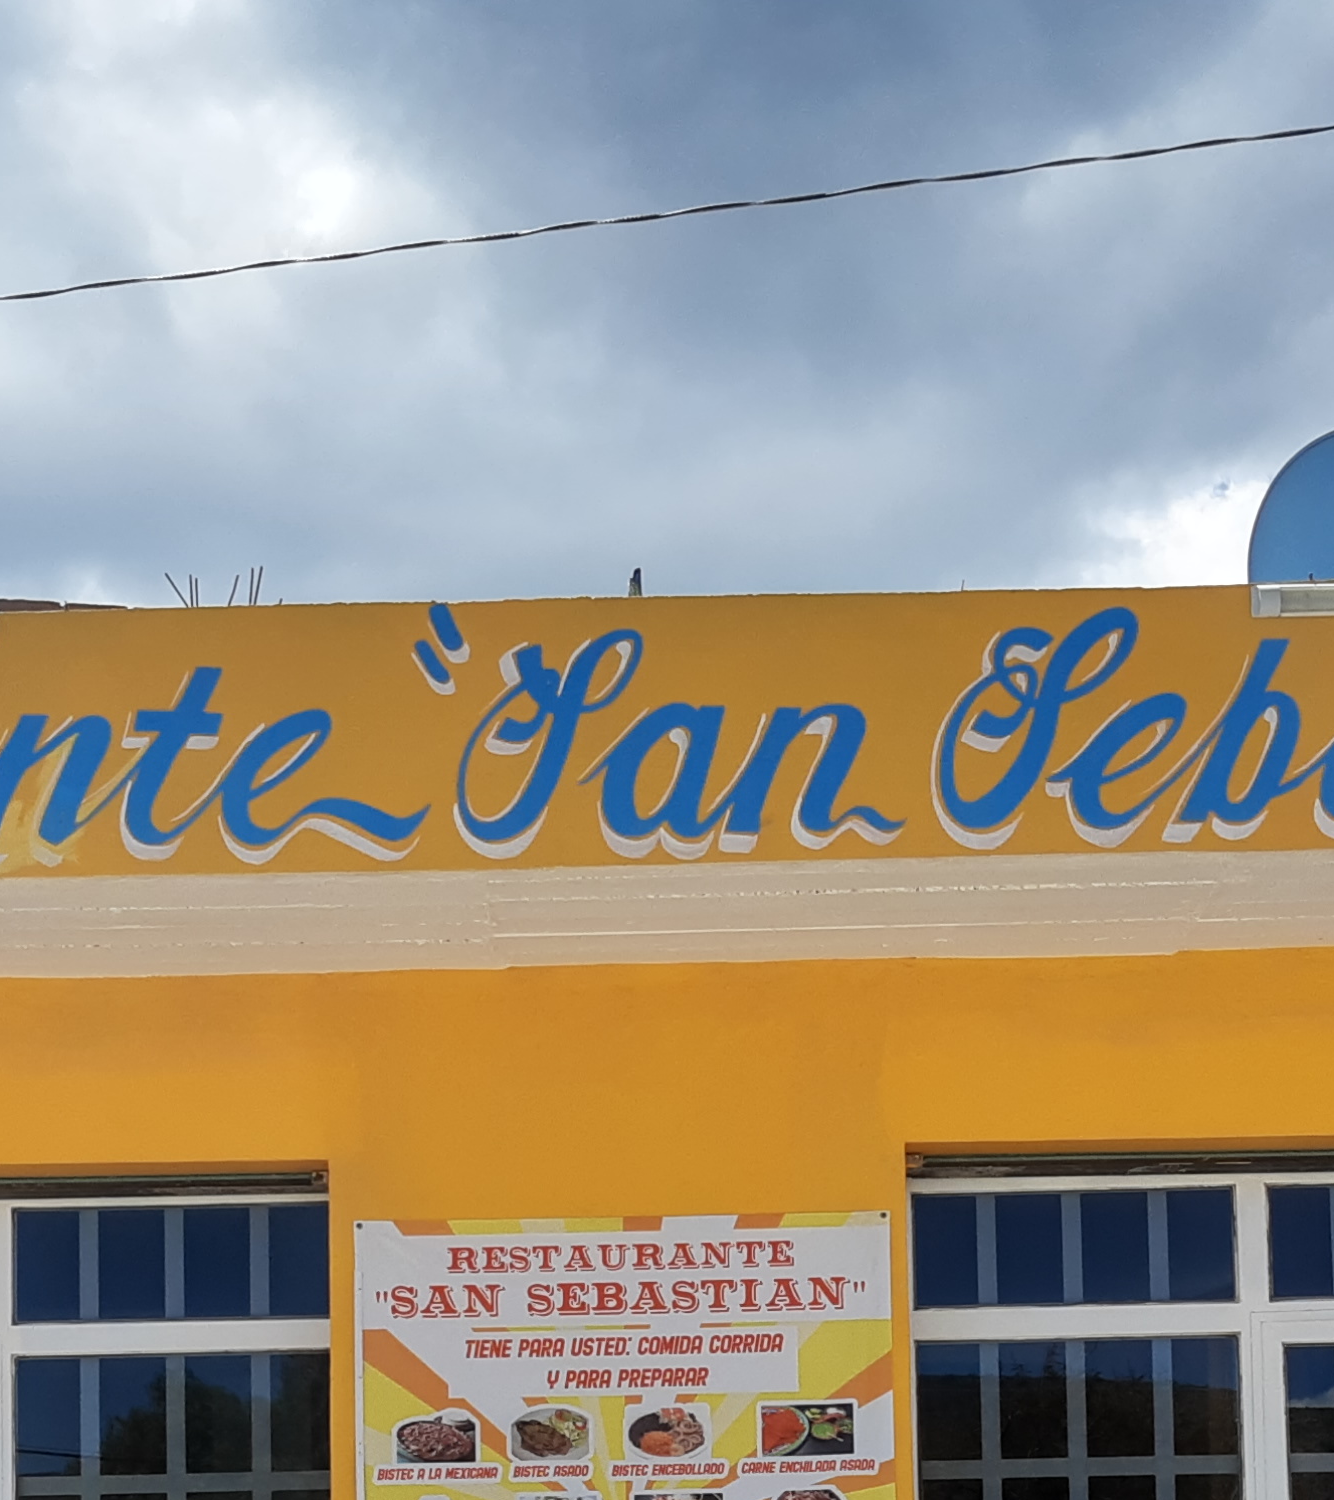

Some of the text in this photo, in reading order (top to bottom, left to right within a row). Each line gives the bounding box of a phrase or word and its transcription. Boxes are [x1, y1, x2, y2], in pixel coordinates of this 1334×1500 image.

[447, 1240, 794, 1274] RESTAURANTE
[375, 1276, 866, 1319] "SAN SEBASTIAN"
[465, 1333, 784, 1358] TIENE PARA USTED: COMIDA CORRIDA
[547, 1367, 709, 1389] Y PARA PREPARAR
[377, 1466, 498, 1481] BISTEC A LA MEXICANA
[513, 1464, 589, 1478] BISTEC ASADO
[611, 1463, 725, 1477] BISTEC ENCEBOLLADO
[741, 1459, 875, 1475] CARNE ENCHILADA ASADA
